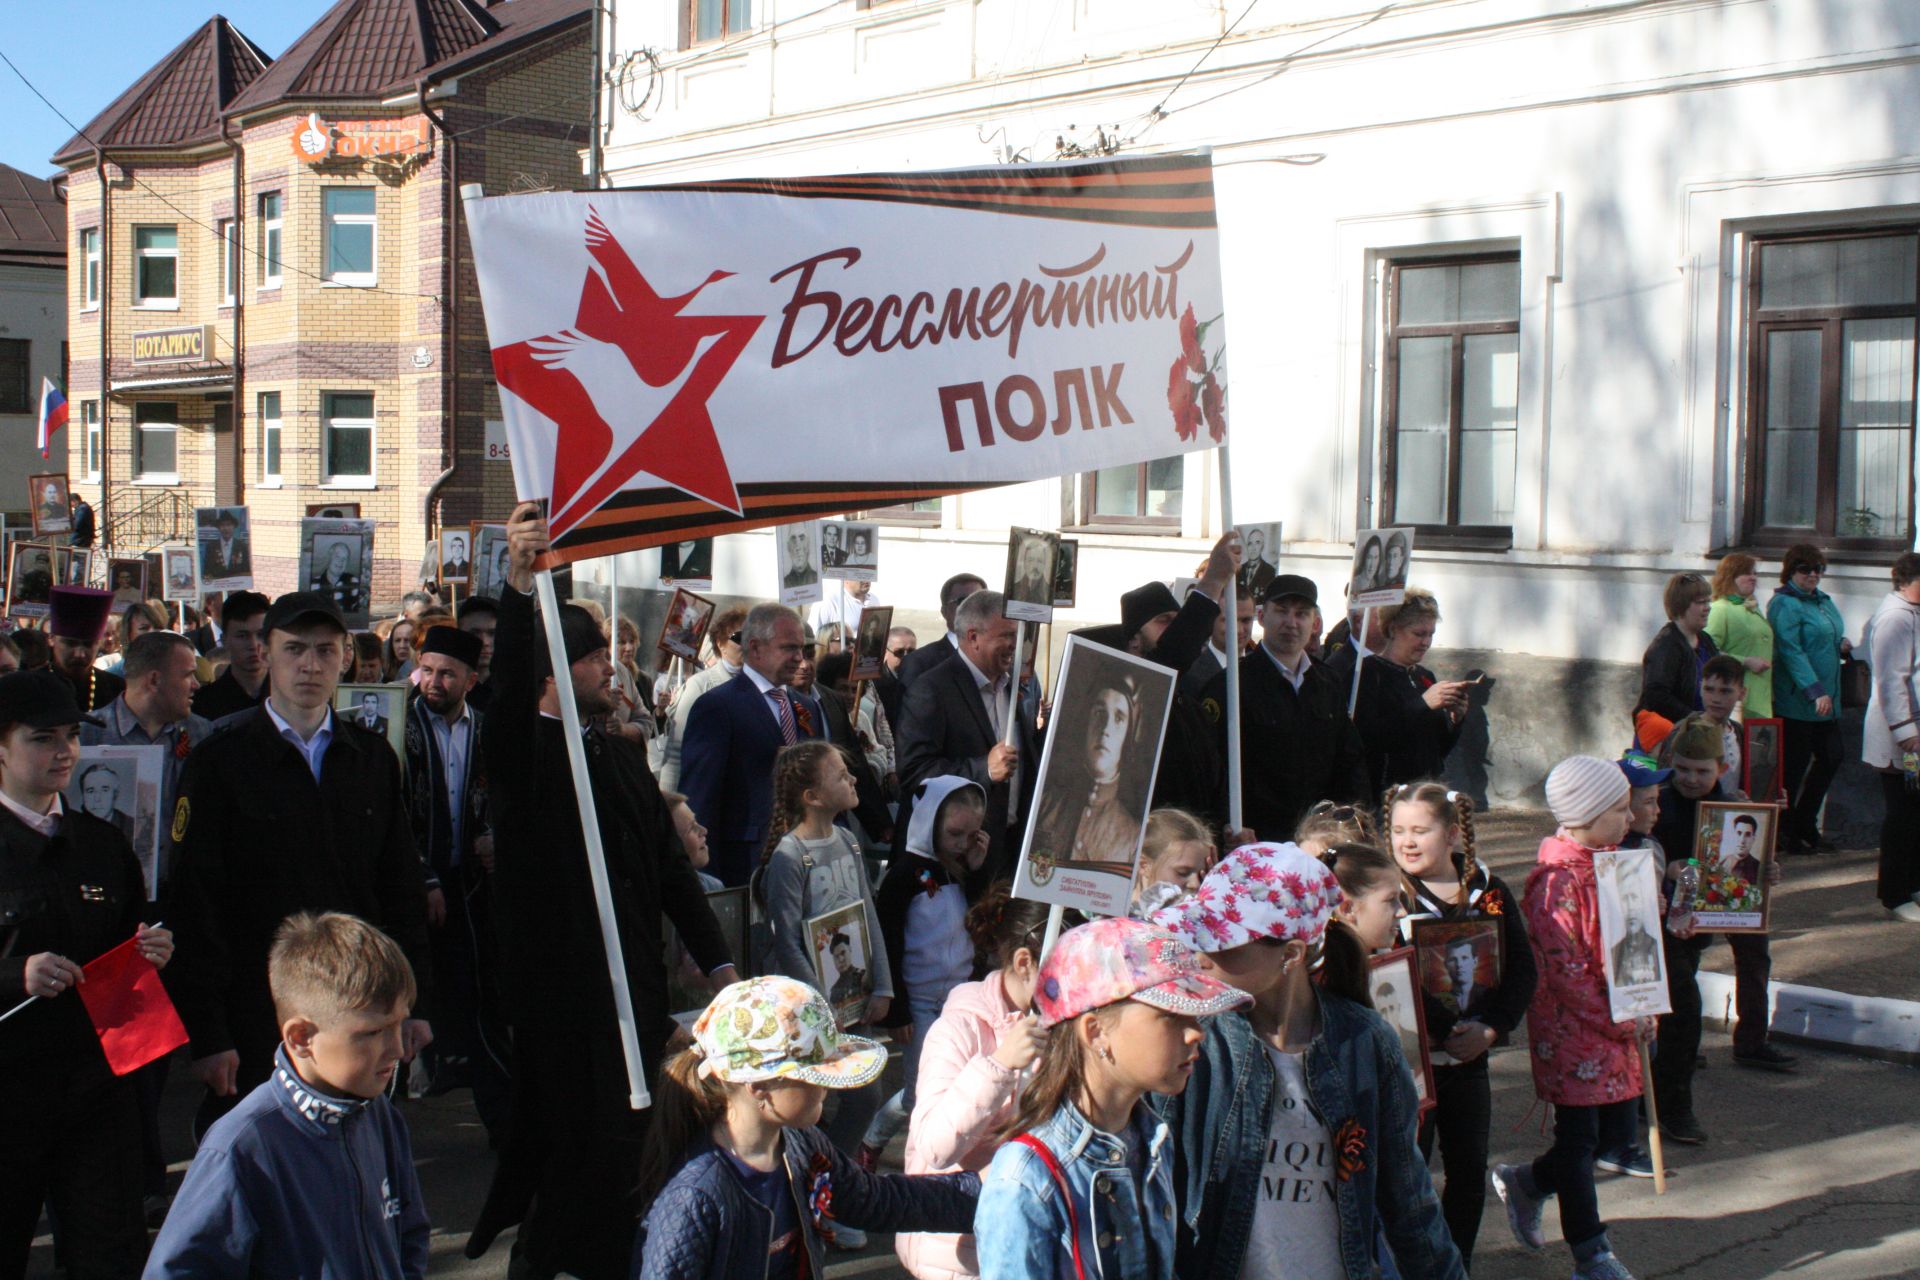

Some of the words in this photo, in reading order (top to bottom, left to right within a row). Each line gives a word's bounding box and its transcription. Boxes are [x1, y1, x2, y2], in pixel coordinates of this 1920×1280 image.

[135, 332, 201, 359] НОТАРИУС
[770, 239, 1194, 369] Бессмертный
[938, 362, 1135, 453] ПОЛК
